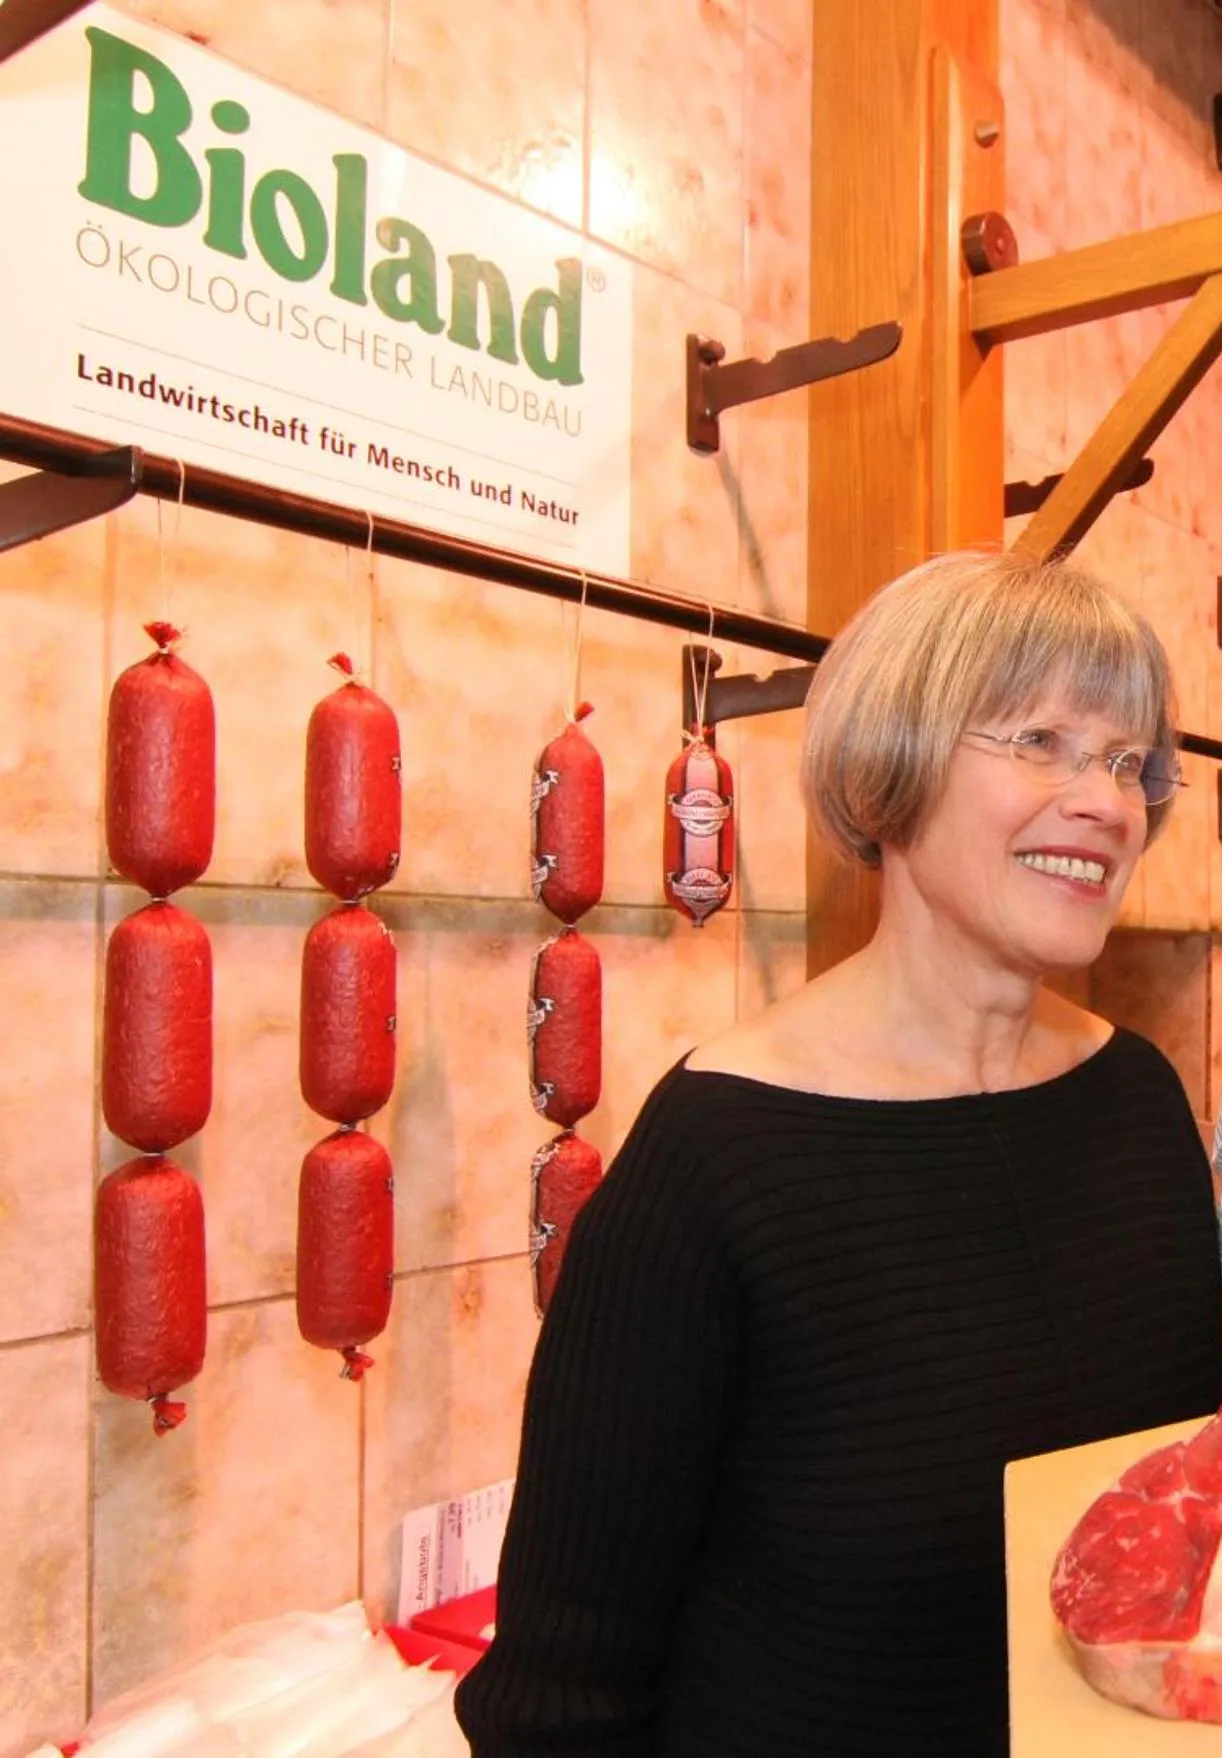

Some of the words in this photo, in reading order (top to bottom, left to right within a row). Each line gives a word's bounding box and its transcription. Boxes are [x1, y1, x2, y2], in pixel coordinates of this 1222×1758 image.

[77, 25, 585, 386] Bioland
[75, 219, 414, 379] ÖKOLOGISCHER
[430, 355, 582, 437] LANDBAU
[77, 353, 310, 445] Landwirtschaft
[319, 426, 358, 459] für
[366, 443, 460, 491] Mensch
[470, 479, 512, 506] und
[520, 489, 579, 526] Natur
